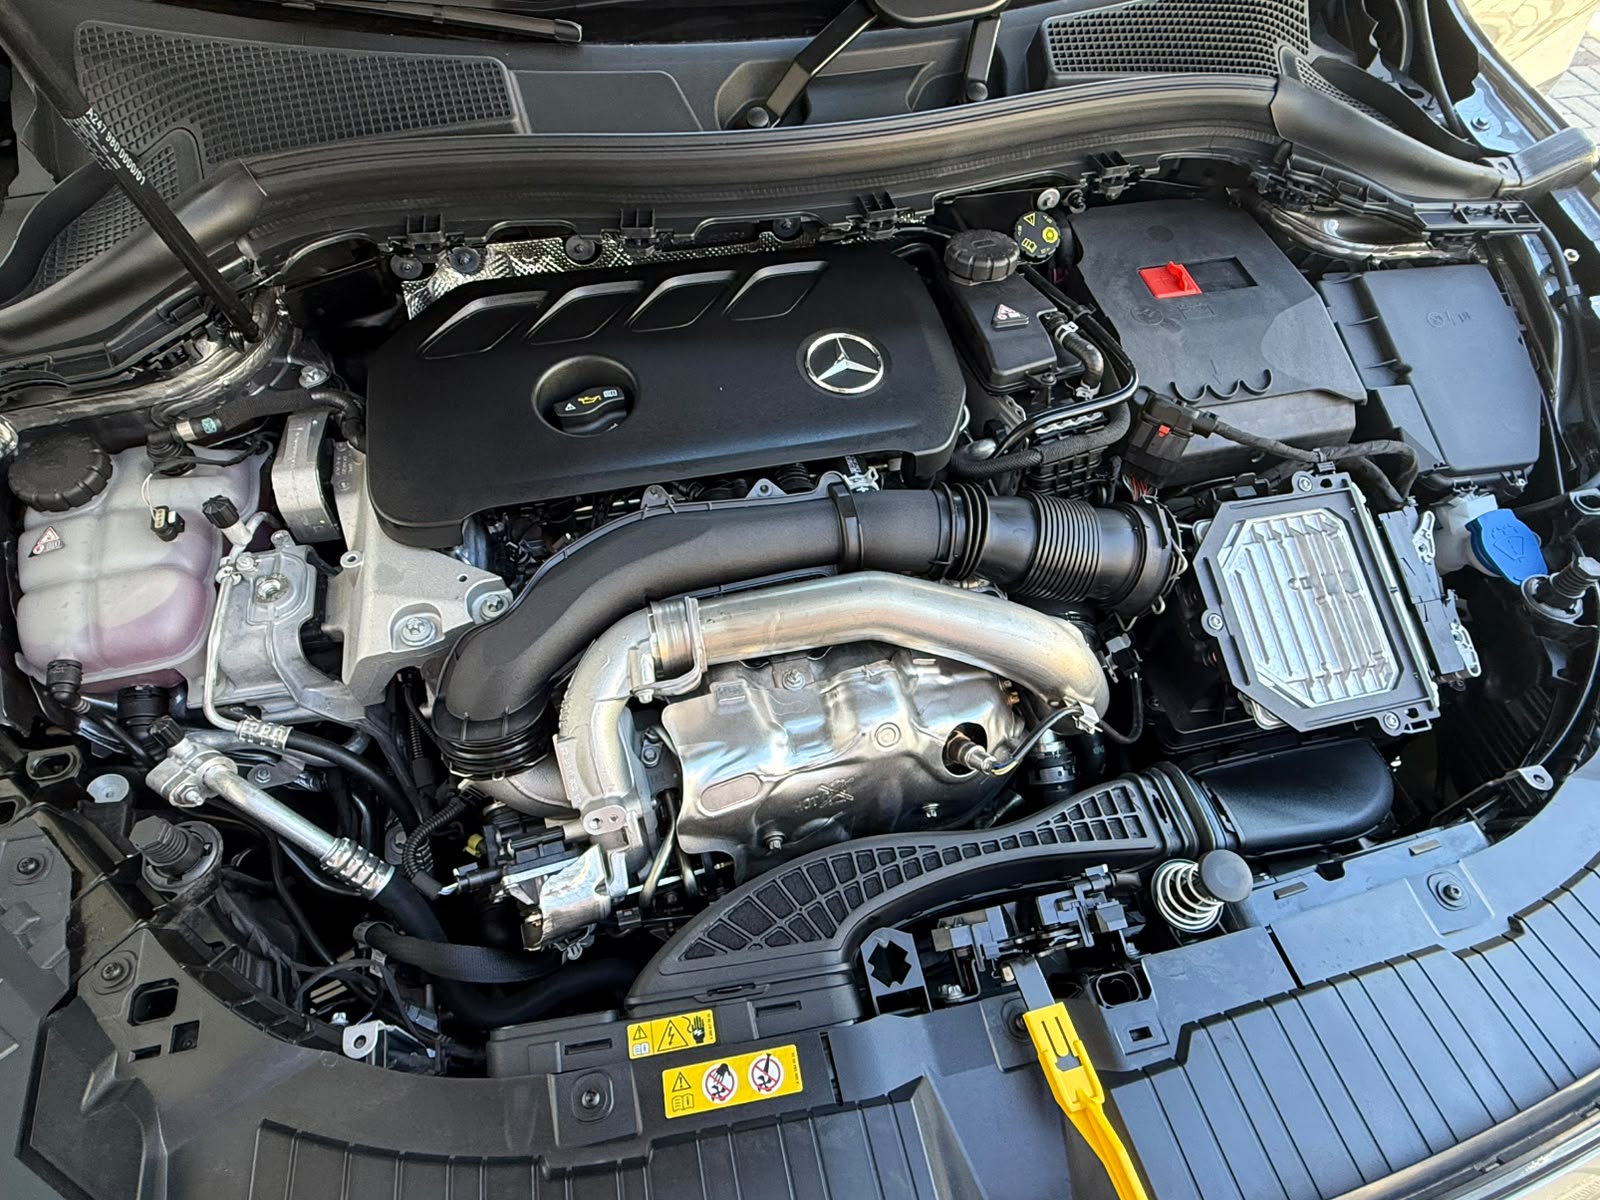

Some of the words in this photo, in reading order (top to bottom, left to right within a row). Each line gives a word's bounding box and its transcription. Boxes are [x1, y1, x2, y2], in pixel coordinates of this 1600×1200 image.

[85, 107, 107, 134] A247
[105, 131, 120, 152] 980
[118, 148, 146, 186] 0000/01
